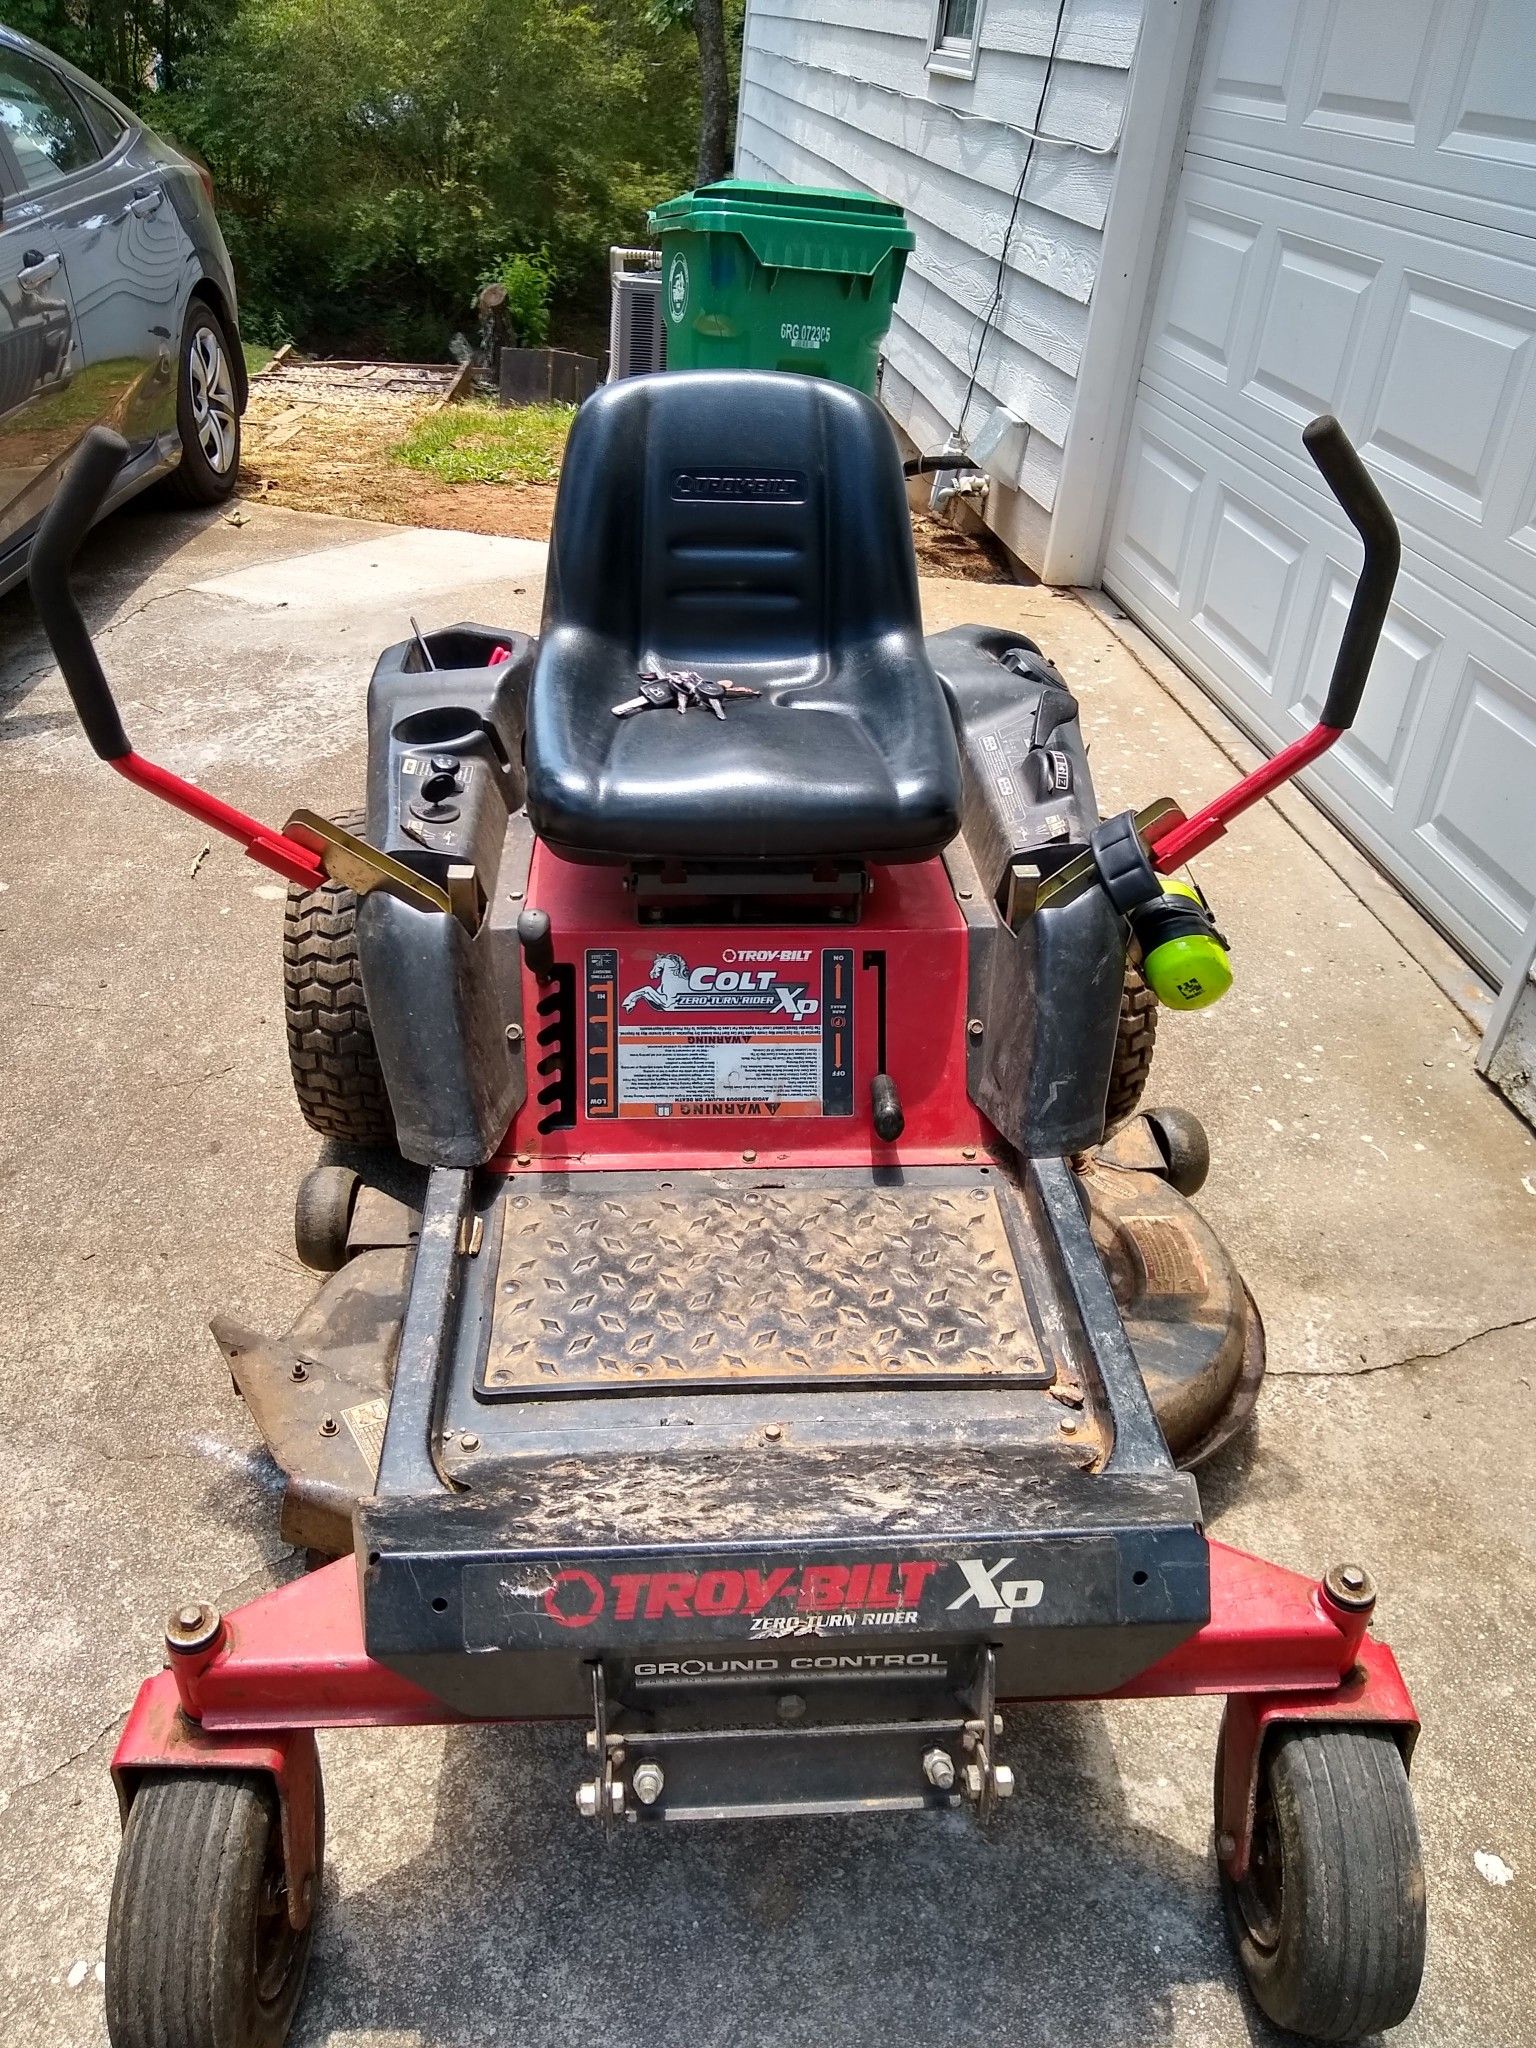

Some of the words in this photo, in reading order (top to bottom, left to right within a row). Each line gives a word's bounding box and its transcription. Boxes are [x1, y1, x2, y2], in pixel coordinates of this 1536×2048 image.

[737, 950, 813, 962] TROY-BILT
[688, 966, 777, 991] COLT
[679, 996, 708, 1005] ZERO
[711, 995, 740, 1005] TURN
[740, 995, 775, 1005] RIDER
[687, 1036, 740, 1044] WARNING
[680, 1103, 762, 1115] WARNING
[609, 1560, 938, 1621] TROY-BILT
[750, 1616, 800, 1631] ZERO
[805, 1613, 857, 1628] TURN
[861, 1611, 919, 1626] RIDER
[634, 1659, 779, 1677] GROUND
[790, 1653, 949, 1670] CONTROL
